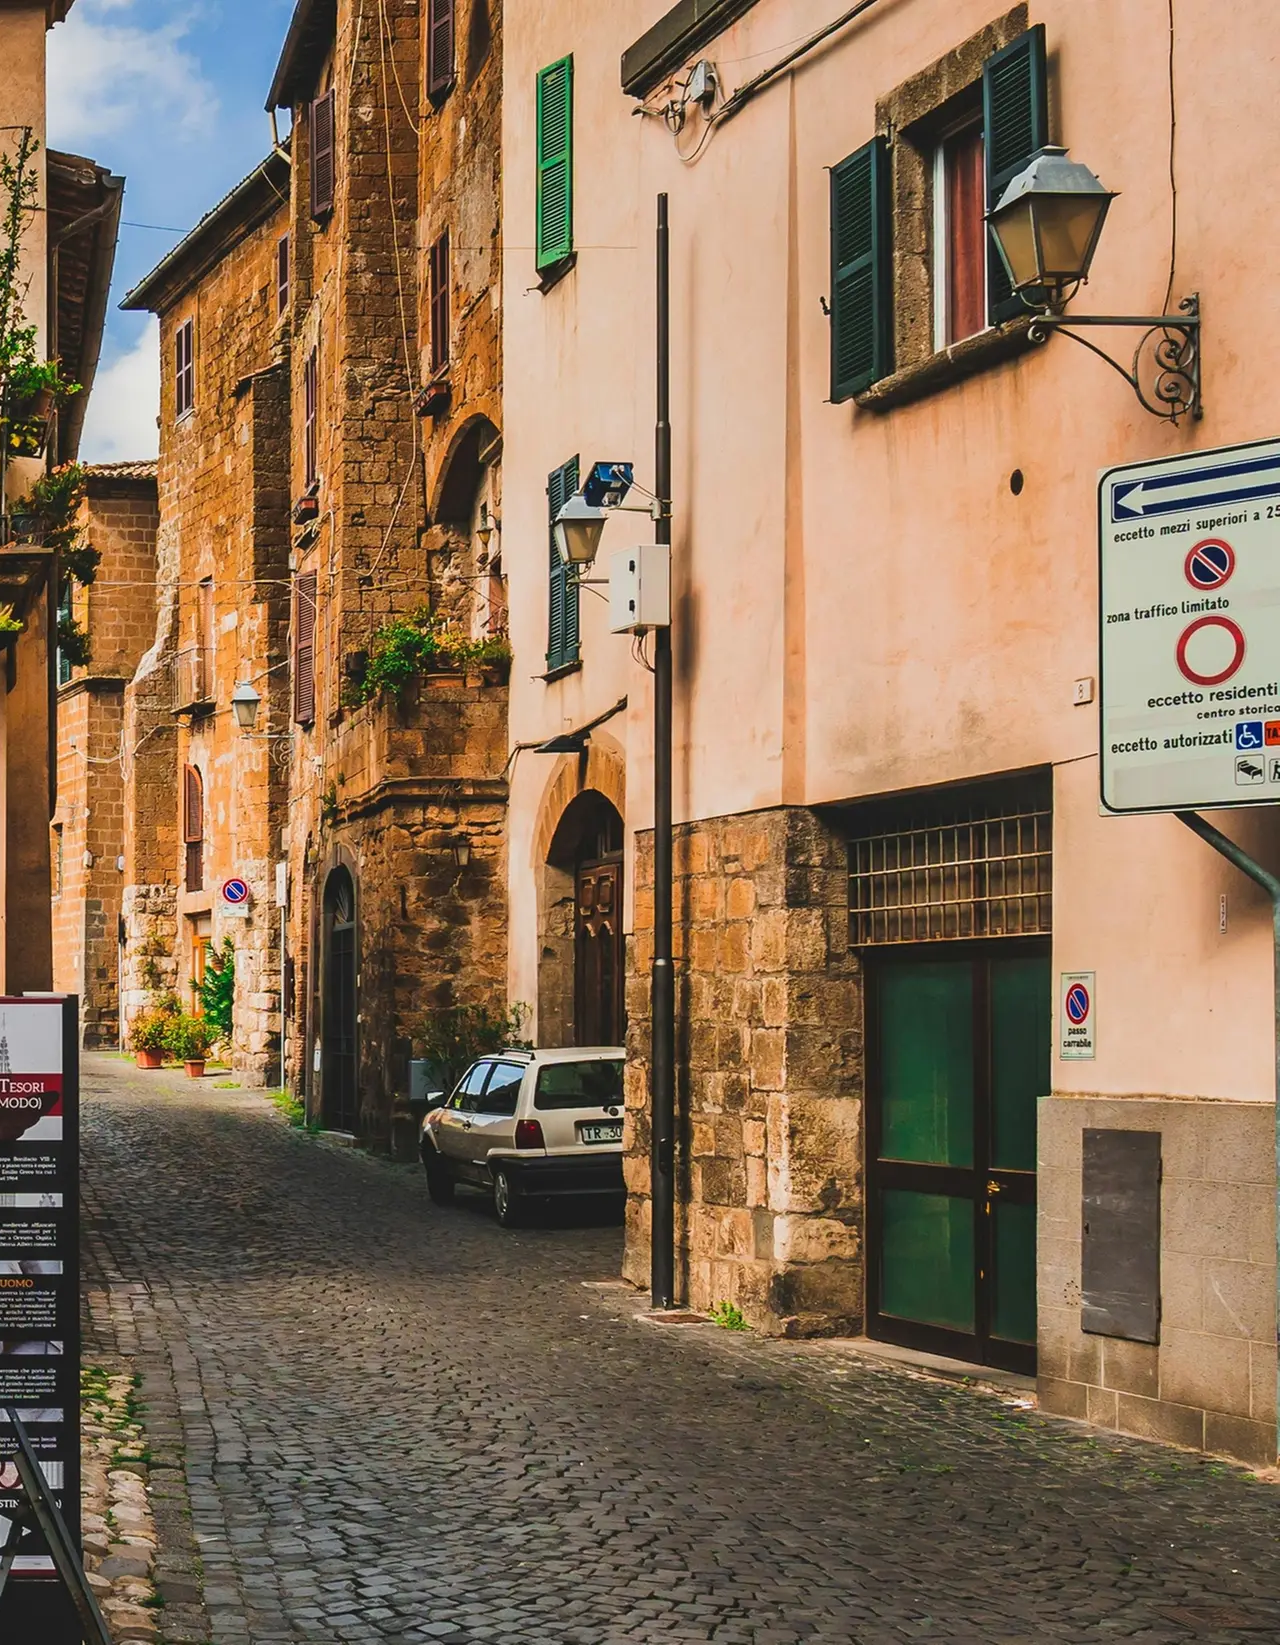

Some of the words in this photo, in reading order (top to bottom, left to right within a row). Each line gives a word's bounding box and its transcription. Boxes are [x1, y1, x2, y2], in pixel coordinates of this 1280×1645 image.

[1114, 526, 1156, 544] eccetto
[1160, 520, 1190, 536] mezzi
[1196, 510, 1247, 533] superiori
[1253, 512, 1260, 520] a
[1106, 608, 1131, 625] zona
[1134, 603, 1178, 620] traffico
[1181, 597, 1230, 614] limitato
[1078, 684, 1084, 699] 8
[1148, 690, 1204, 709] eccetto
[1208, 682, 1278, 702] residenti
[1196, 708, 1236, 720] centro
[1111, 736, 1158, 754] eccetto
[1163, 729, 1233, 750] autorizzati
[1266, 728, 1280, 739] TA
[1068, 1028, 1087, 1036] passo
[1063, 1039, 1092, 1048] carrabile
[584, 1128, 602, 1139] TR
